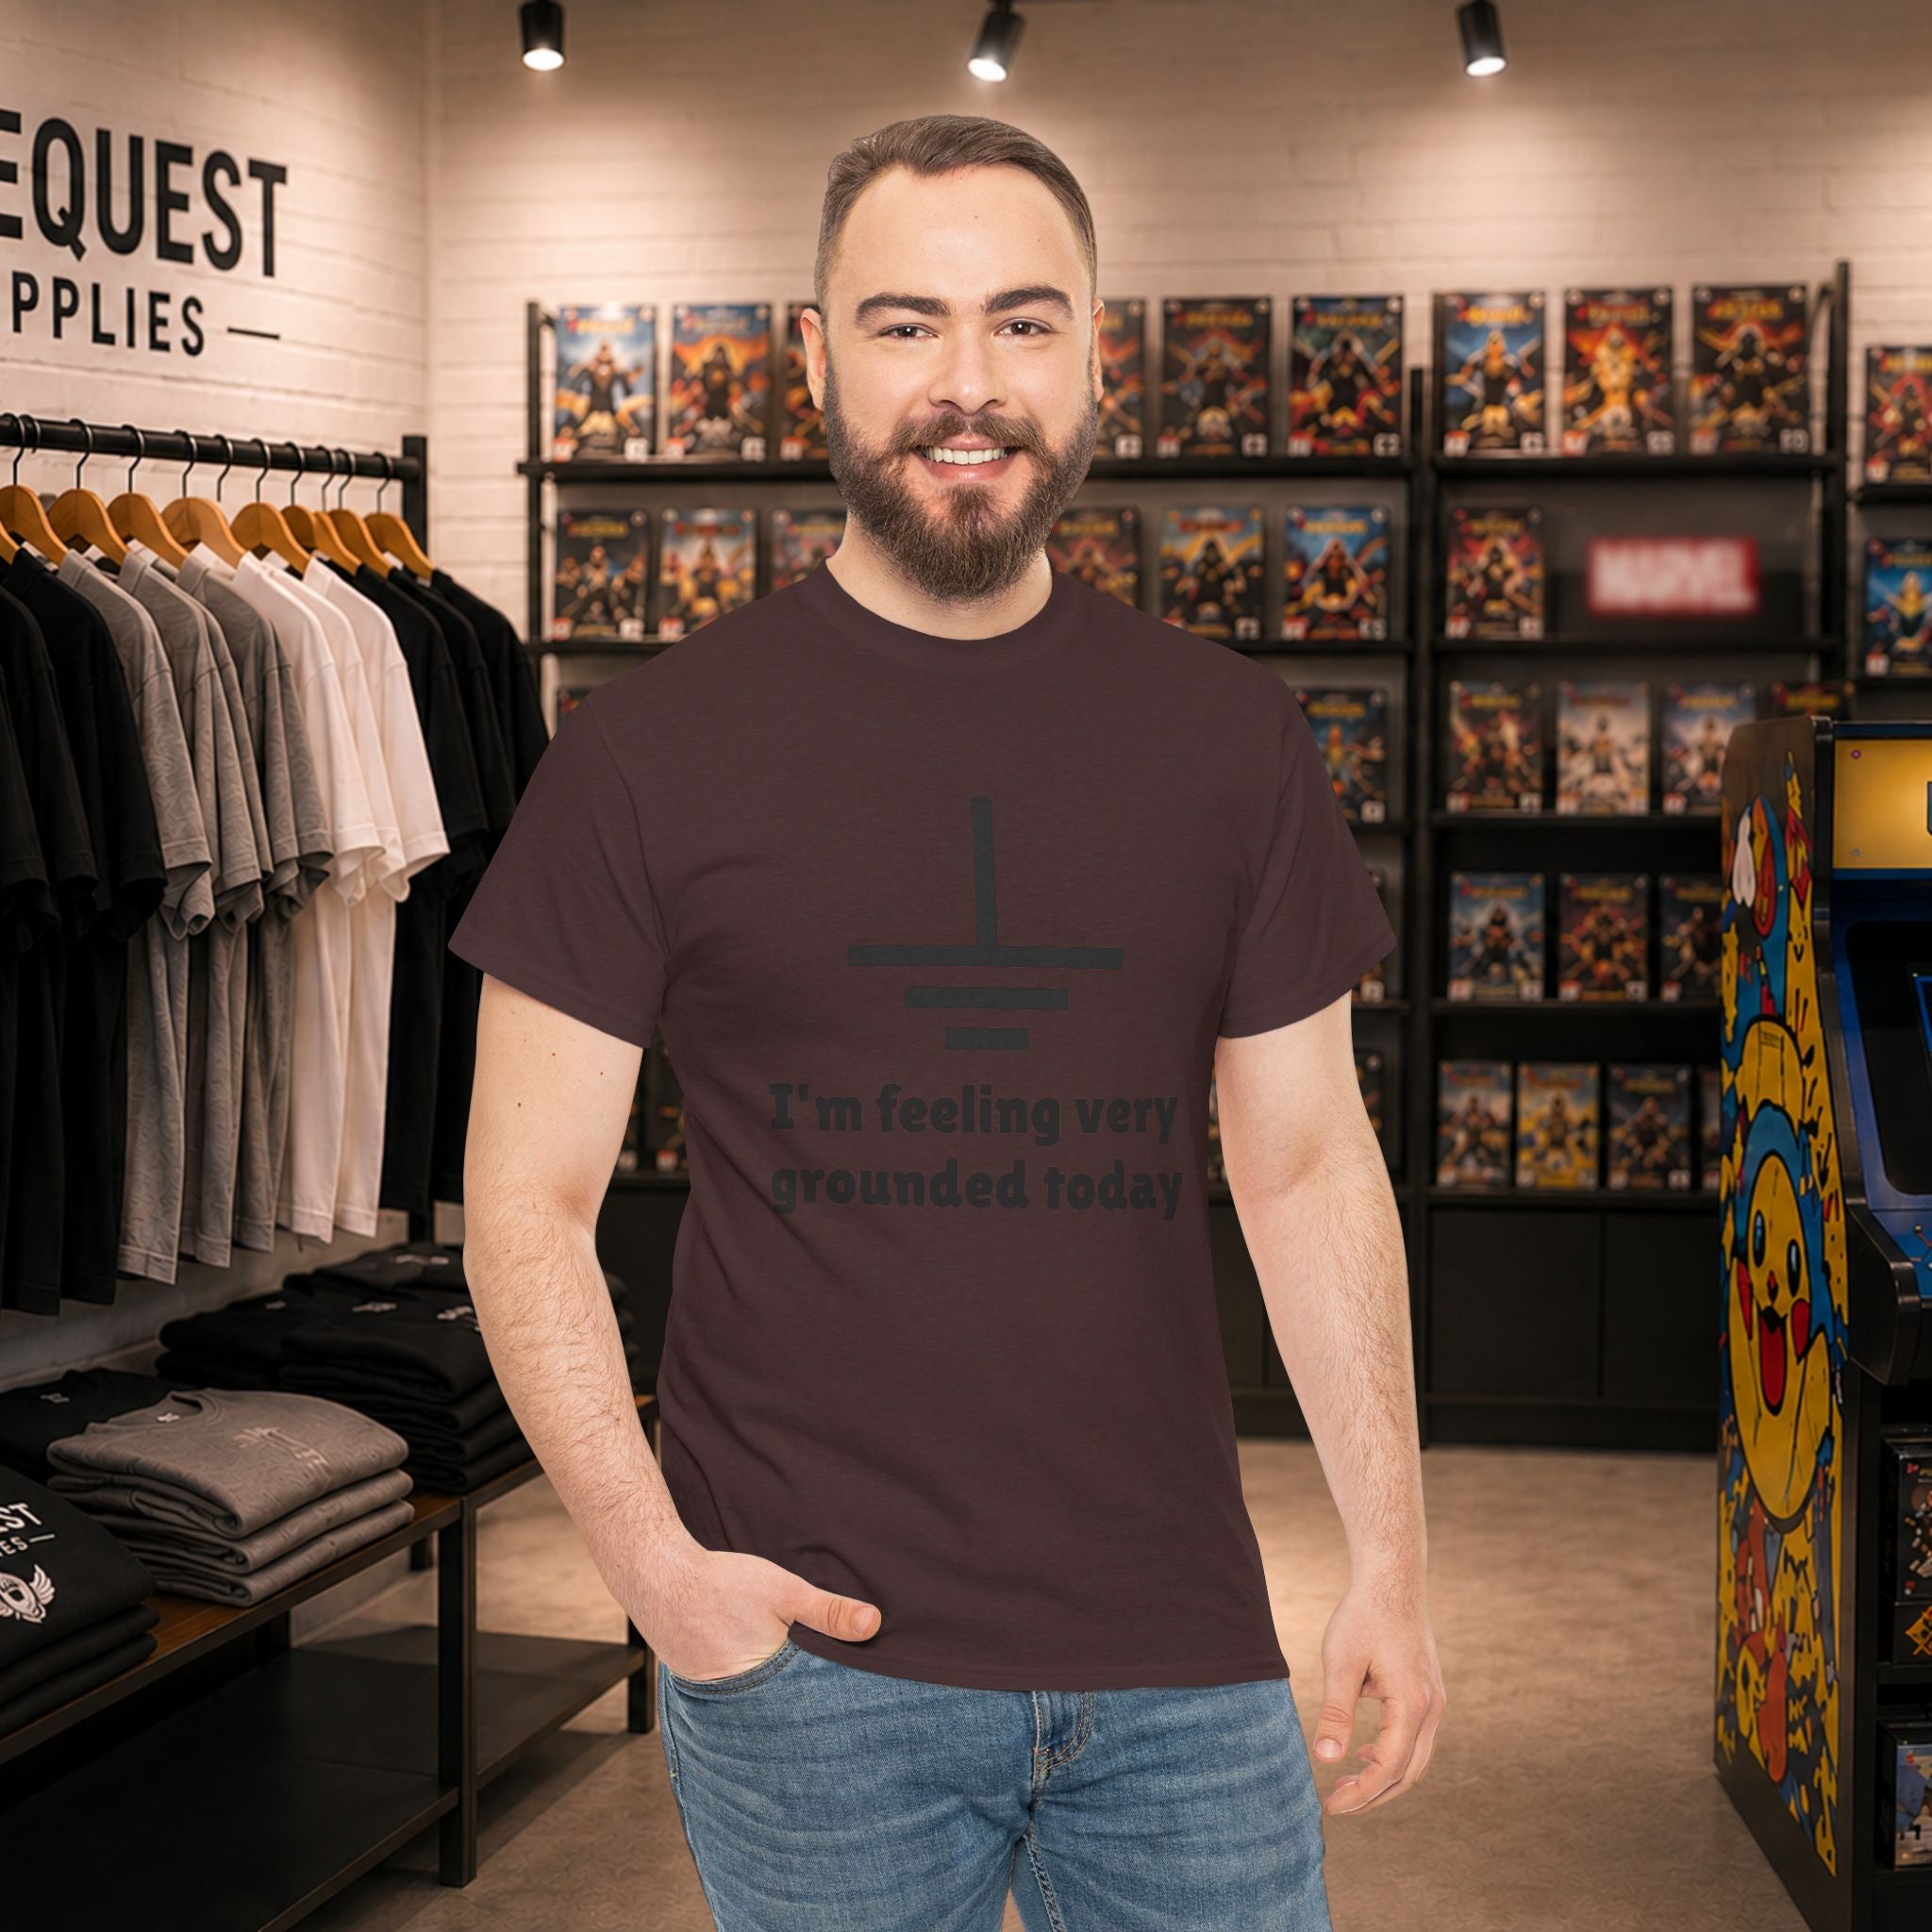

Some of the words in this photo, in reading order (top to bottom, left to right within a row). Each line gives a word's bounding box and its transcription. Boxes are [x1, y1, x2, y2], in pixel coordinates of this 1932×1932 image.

[11, 270, 205, 358] PPLIES
[769, 1083, 862, 1132] I'm
[877, 1083, 1060, 1146] feeling
[1074, 1097, 1178, 1145] very
[771, 1158, 1030, 1214] grounded
[1043, 1159, 1184, 1221] today
[0, 1503, 42, 1533] ST
[0, 1536, 29, 1557] ES
